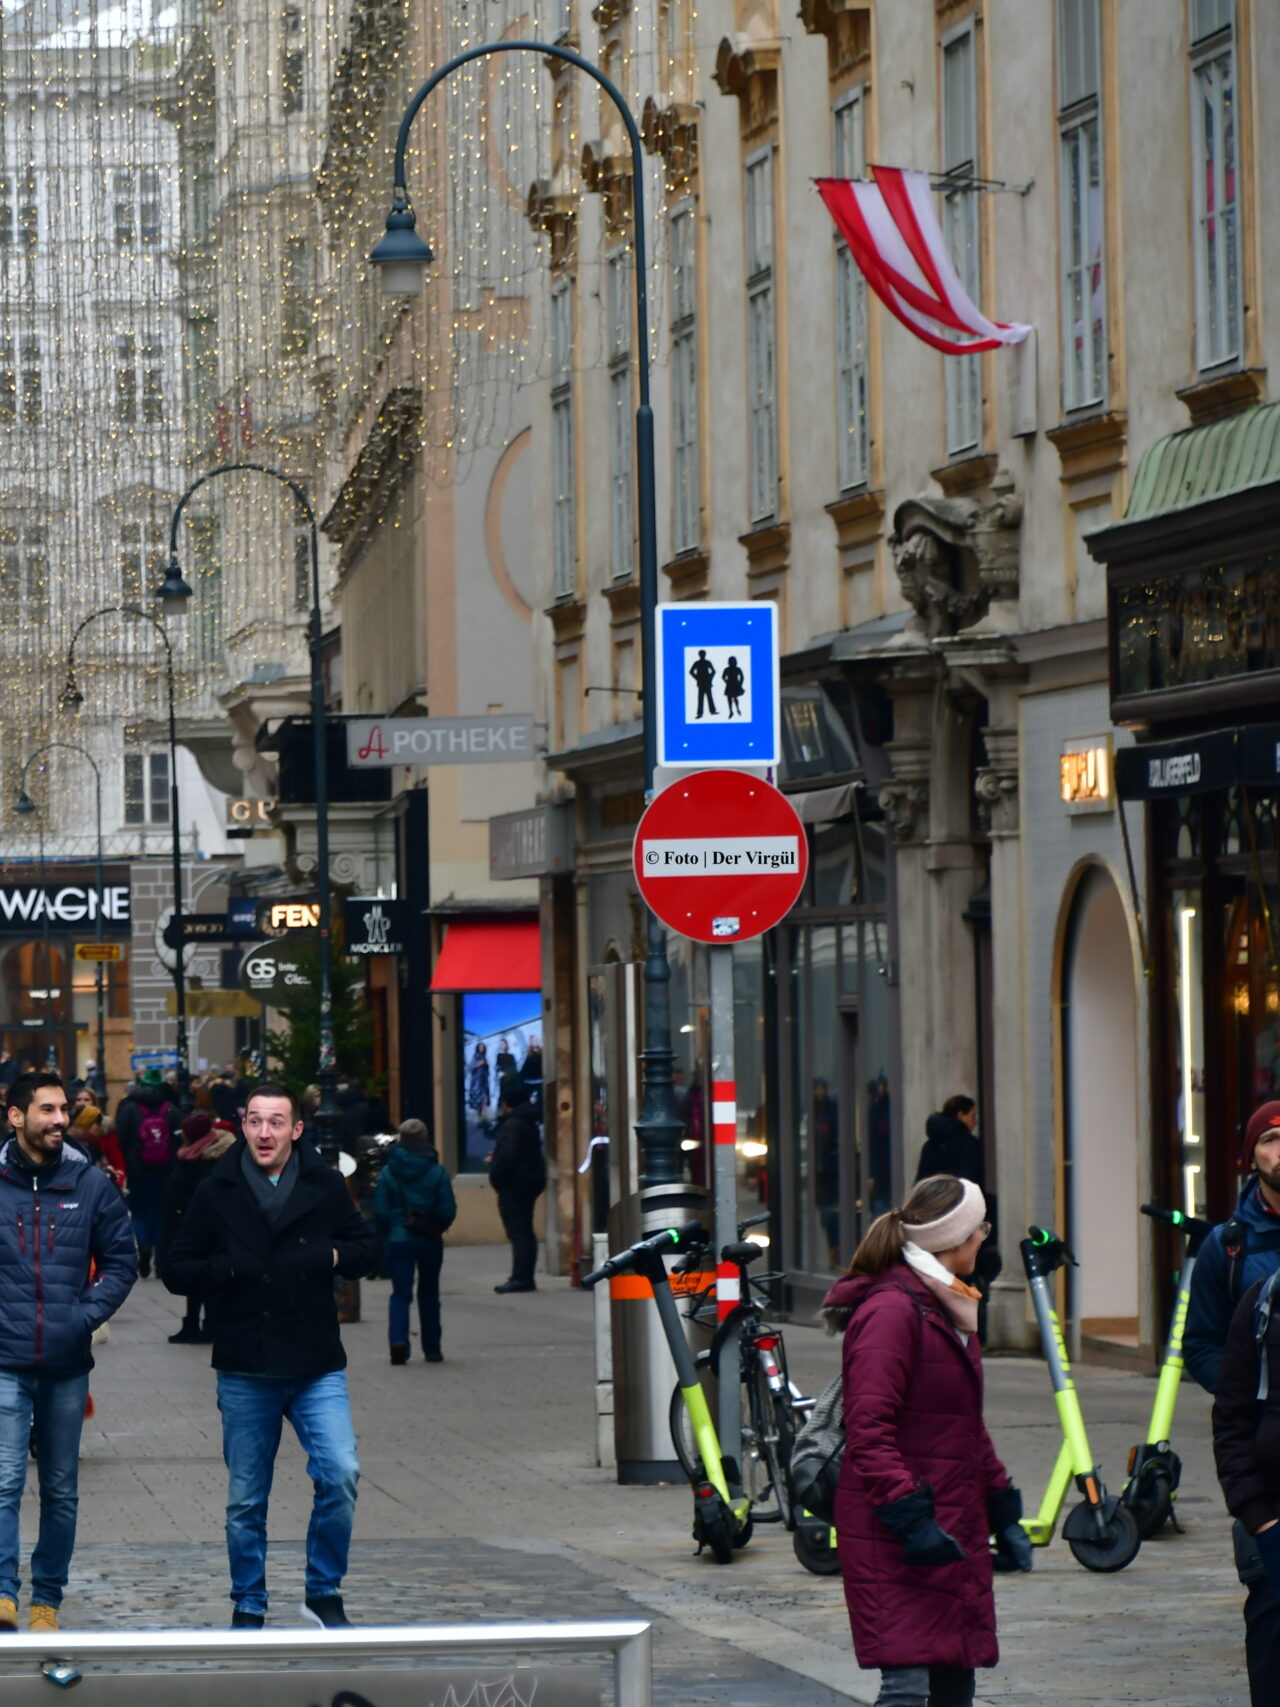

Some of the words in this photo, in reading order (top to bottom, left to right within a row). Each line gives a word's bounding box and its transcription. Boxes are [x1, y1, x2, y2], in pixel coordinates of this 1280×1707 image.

[358, 725, 527, 760] APOTHEKE
[350, 943, 403, 954] MONCLER
[29, 988, 61, 999] WAGER
